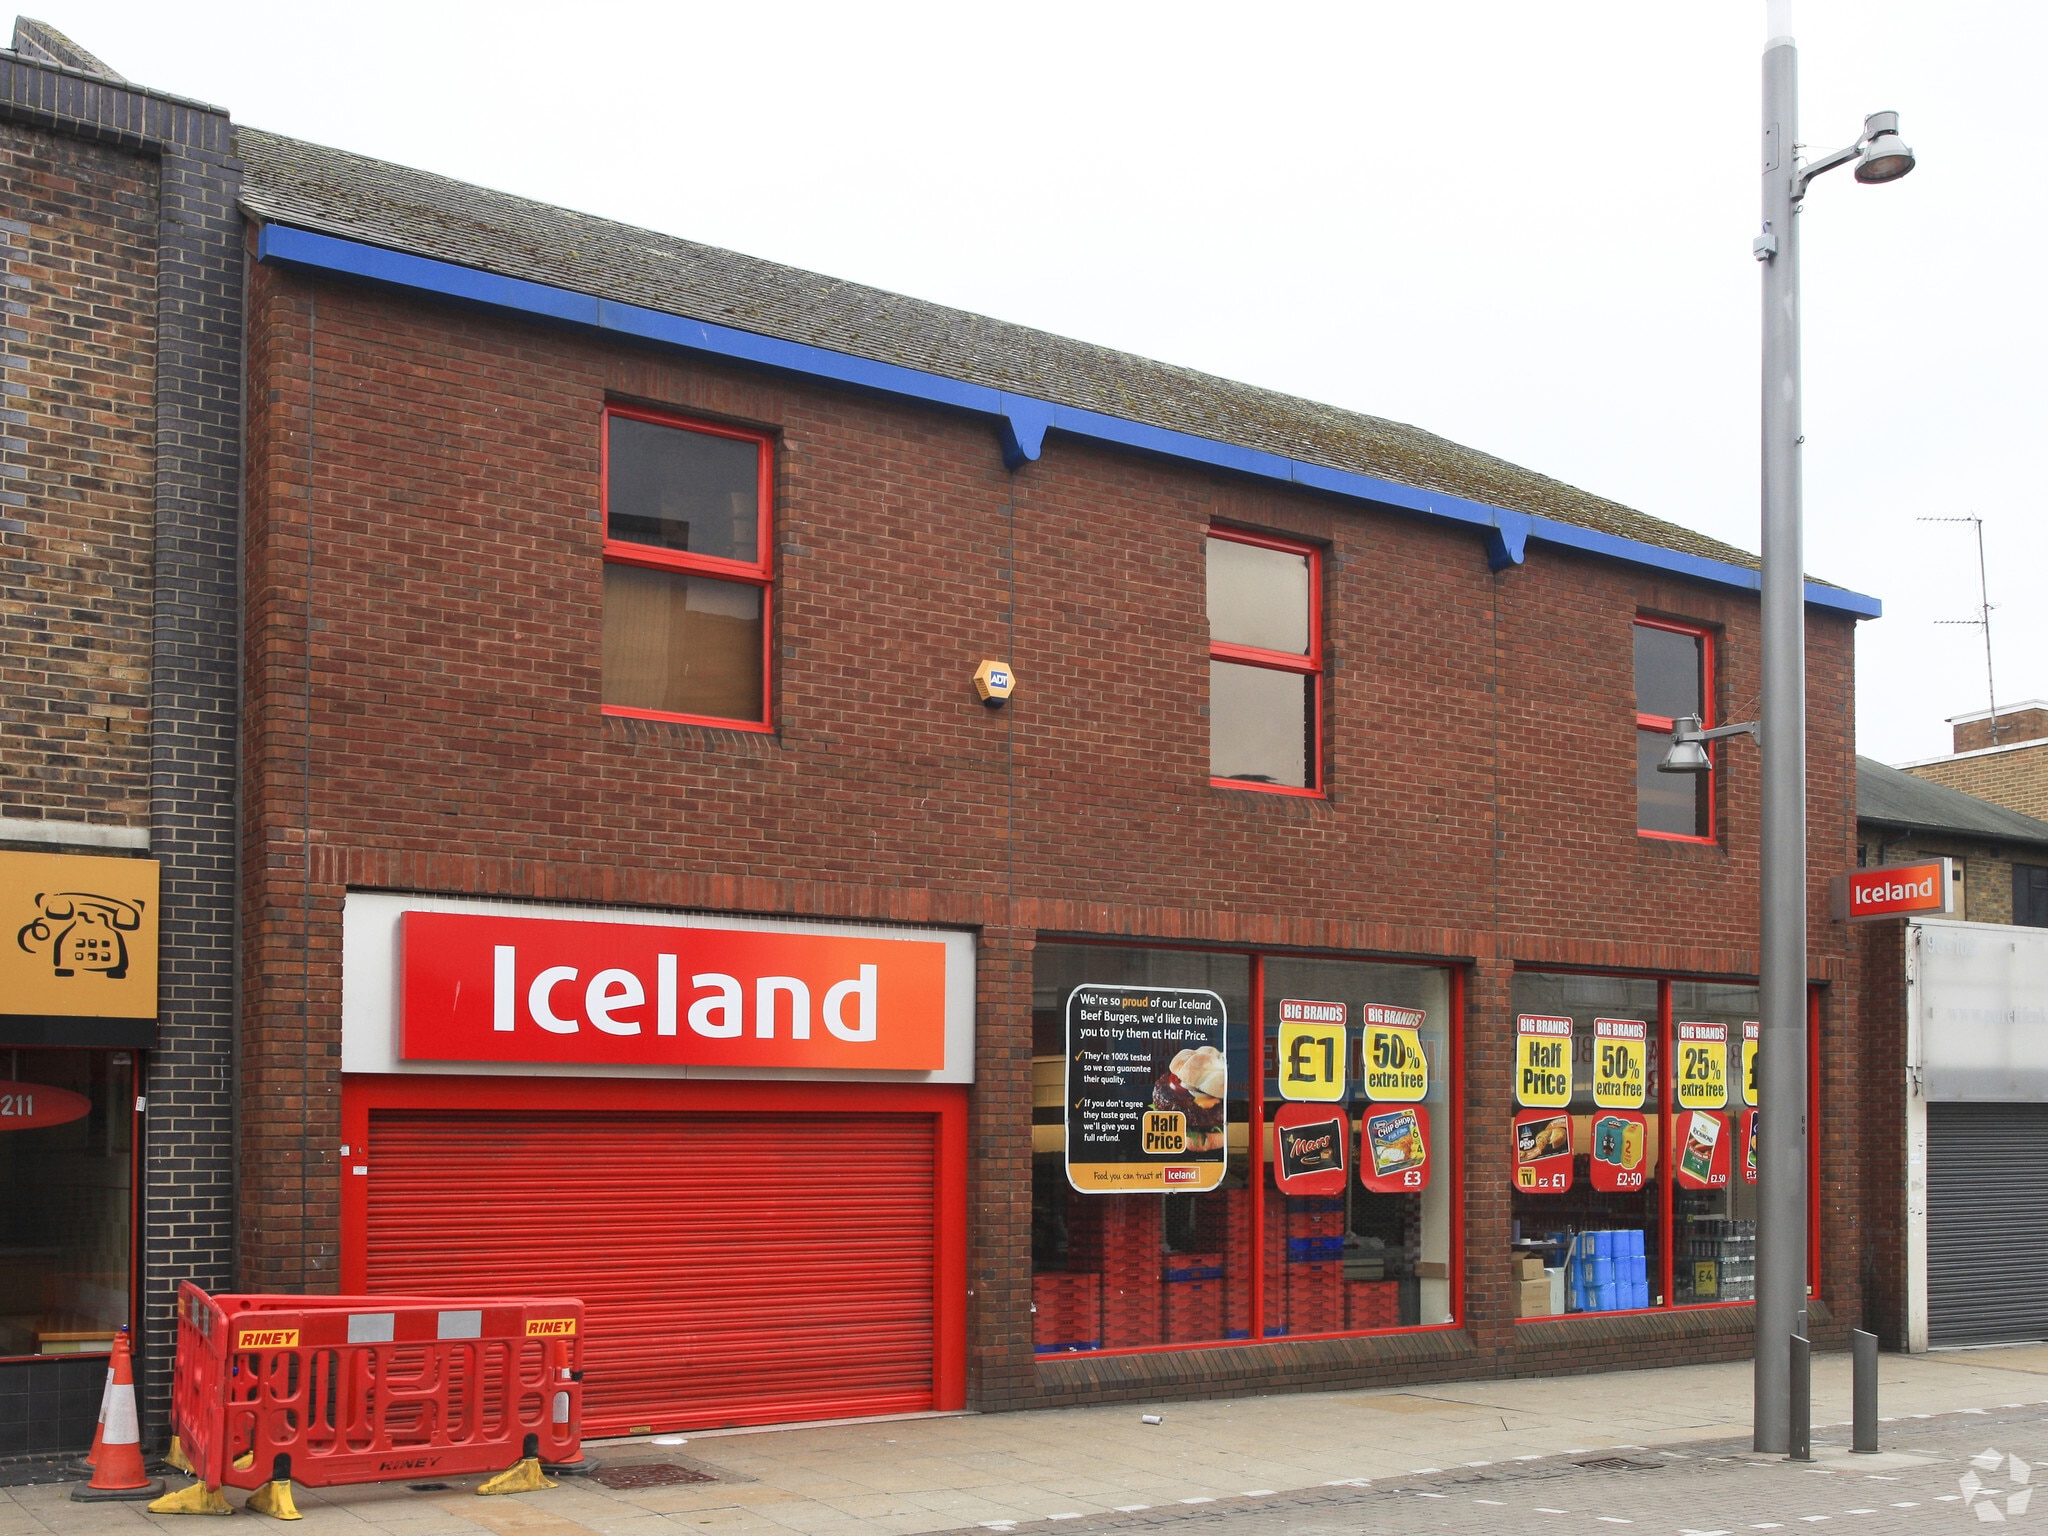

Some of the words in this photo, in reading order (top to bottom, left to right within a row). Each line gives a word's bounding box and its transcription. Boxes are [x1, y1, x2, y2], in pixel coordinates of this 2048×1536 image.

[991, 674, 1008, 686] ADT
[1855, 877, 1933, 904] Iceland
[494, 945, 877, 1043] Iceland
[1080, 994, 1108, 1005] We're
[1110, 996, 1120, 1006] so
[1122, 997, 1148, 1008] proud
[1150, 998, 1159, 1008] of
[1162, 1000, 1176, 1008] our
[1179, 998, 1211, 1010] Iceland
[1081, 1010, 1101, 1021] Beef
[1104, 1012, 1140, 1024] Burgers,
[1142, 1013, 1163, 1023] we'd
[1166, 1013, 1180, 1024] like
[1183, 1015, 1192, 1025] to
[1194, 1015, 1218, 1025] invite
[1284, 1005, 1301, 1018] BIG
[1304, 1006, 1342, 1021] BRANDS
[1369, 1010, 1384, 1022] BIG
[1384, 1011, 1421, 1026] BRANDS
[1080, 1029, 1097, 1039] you
[1100, 1027, 1109, 1038] to
[1112, 1029, 1124, 1040] try
[1126, 1028, 1149, 1039] them
[1152, 1029, 1161, 1039] at
[1164, 1029, 1183, 1040] Half
[1185, 1030, 1208, 1041] Price.
[1520, 1019, 1535, 1032] BIG
[1536, 1020, 1569, 1034] BRANDS
[1597, 1023, 1611, 1035] BIG
[1612, 1024, 1643, 1038] BRANDS
[1681, 1028, 1695, 1039] BIG
[1696, 1029, 1724, 1040] BRANDS
[1746, 1026, 1758, 1037] BIG
[1084, 1051, 1109, 1061] They're
[1111, 1053, 1129, 1061] 100%
[1130, 1054, 1151, 1062] tested
[1288, 1036, 1334, 1082] £1
[1373, 1034, 1420, 1069] 50%
[1530, 1042, 1561, 1068] Half
[1117, 1065, 1151, 1074] guarantee
[1602, 1046, 1639, 1079] 50%
[1686, 1048, 1720, 1080] 25%
[1084, 1075, 1099, 1083] their
[1101, 1075, 1126, 1085] quality.
[1369, 1073, 1398, 1088] extra
[1401, 1072, 1423, 1088] free
[1524, 1069, 1565, 1095] Price
[1597, 1082, 1620, 1096] extra
[1623, 1082, 1642, 1096] free
[1681, 1083, 1704, 1096] extra
[1706, 1083, 1723, 1096] free
[0, 1094, 33, 1116] 211
[1084, 1099, 1090, 1107] If
[1092, 1101, 1104, 1110] you
[1106, 1100, 1123, 1108] don't
[1125, 1101, 1143, 1110] agree
[1084, 1111, 1099, 1120] they
[1119, 1112, 1138, 1121] great,
[1151, 1115, 1178, 1131] Half
[1084, 1123, 1100, 1131] we'll
[1102, 1123, 1115, 1133] give
[1117, 1124, 1129, 1132] you
[1084, 1134, 1095, 1142] full
[1097, 1134, 1120, 1142] refund.
[1147, 1133, 1182, 1149] Price
[1290, 1135, 1331, 1158] Mars
[1094, 1171, 1108, 1180] Food
[1110, 1173, 1121, 1182] you
[1168, 1171, 1196, 1180] Iceland
[1404, 1171, 1421, 1186] £3
[1522, 1174, 1532, 1185] TV
[1552, 1174, 1565, 1187] £1
[1698, 1270, 1713, 1282] £4
[528, 1320, 574, 1334] RINEY
[242, 1332, 297, 1346] RINEY
[379, 1456, 442, 1471] RINEY
